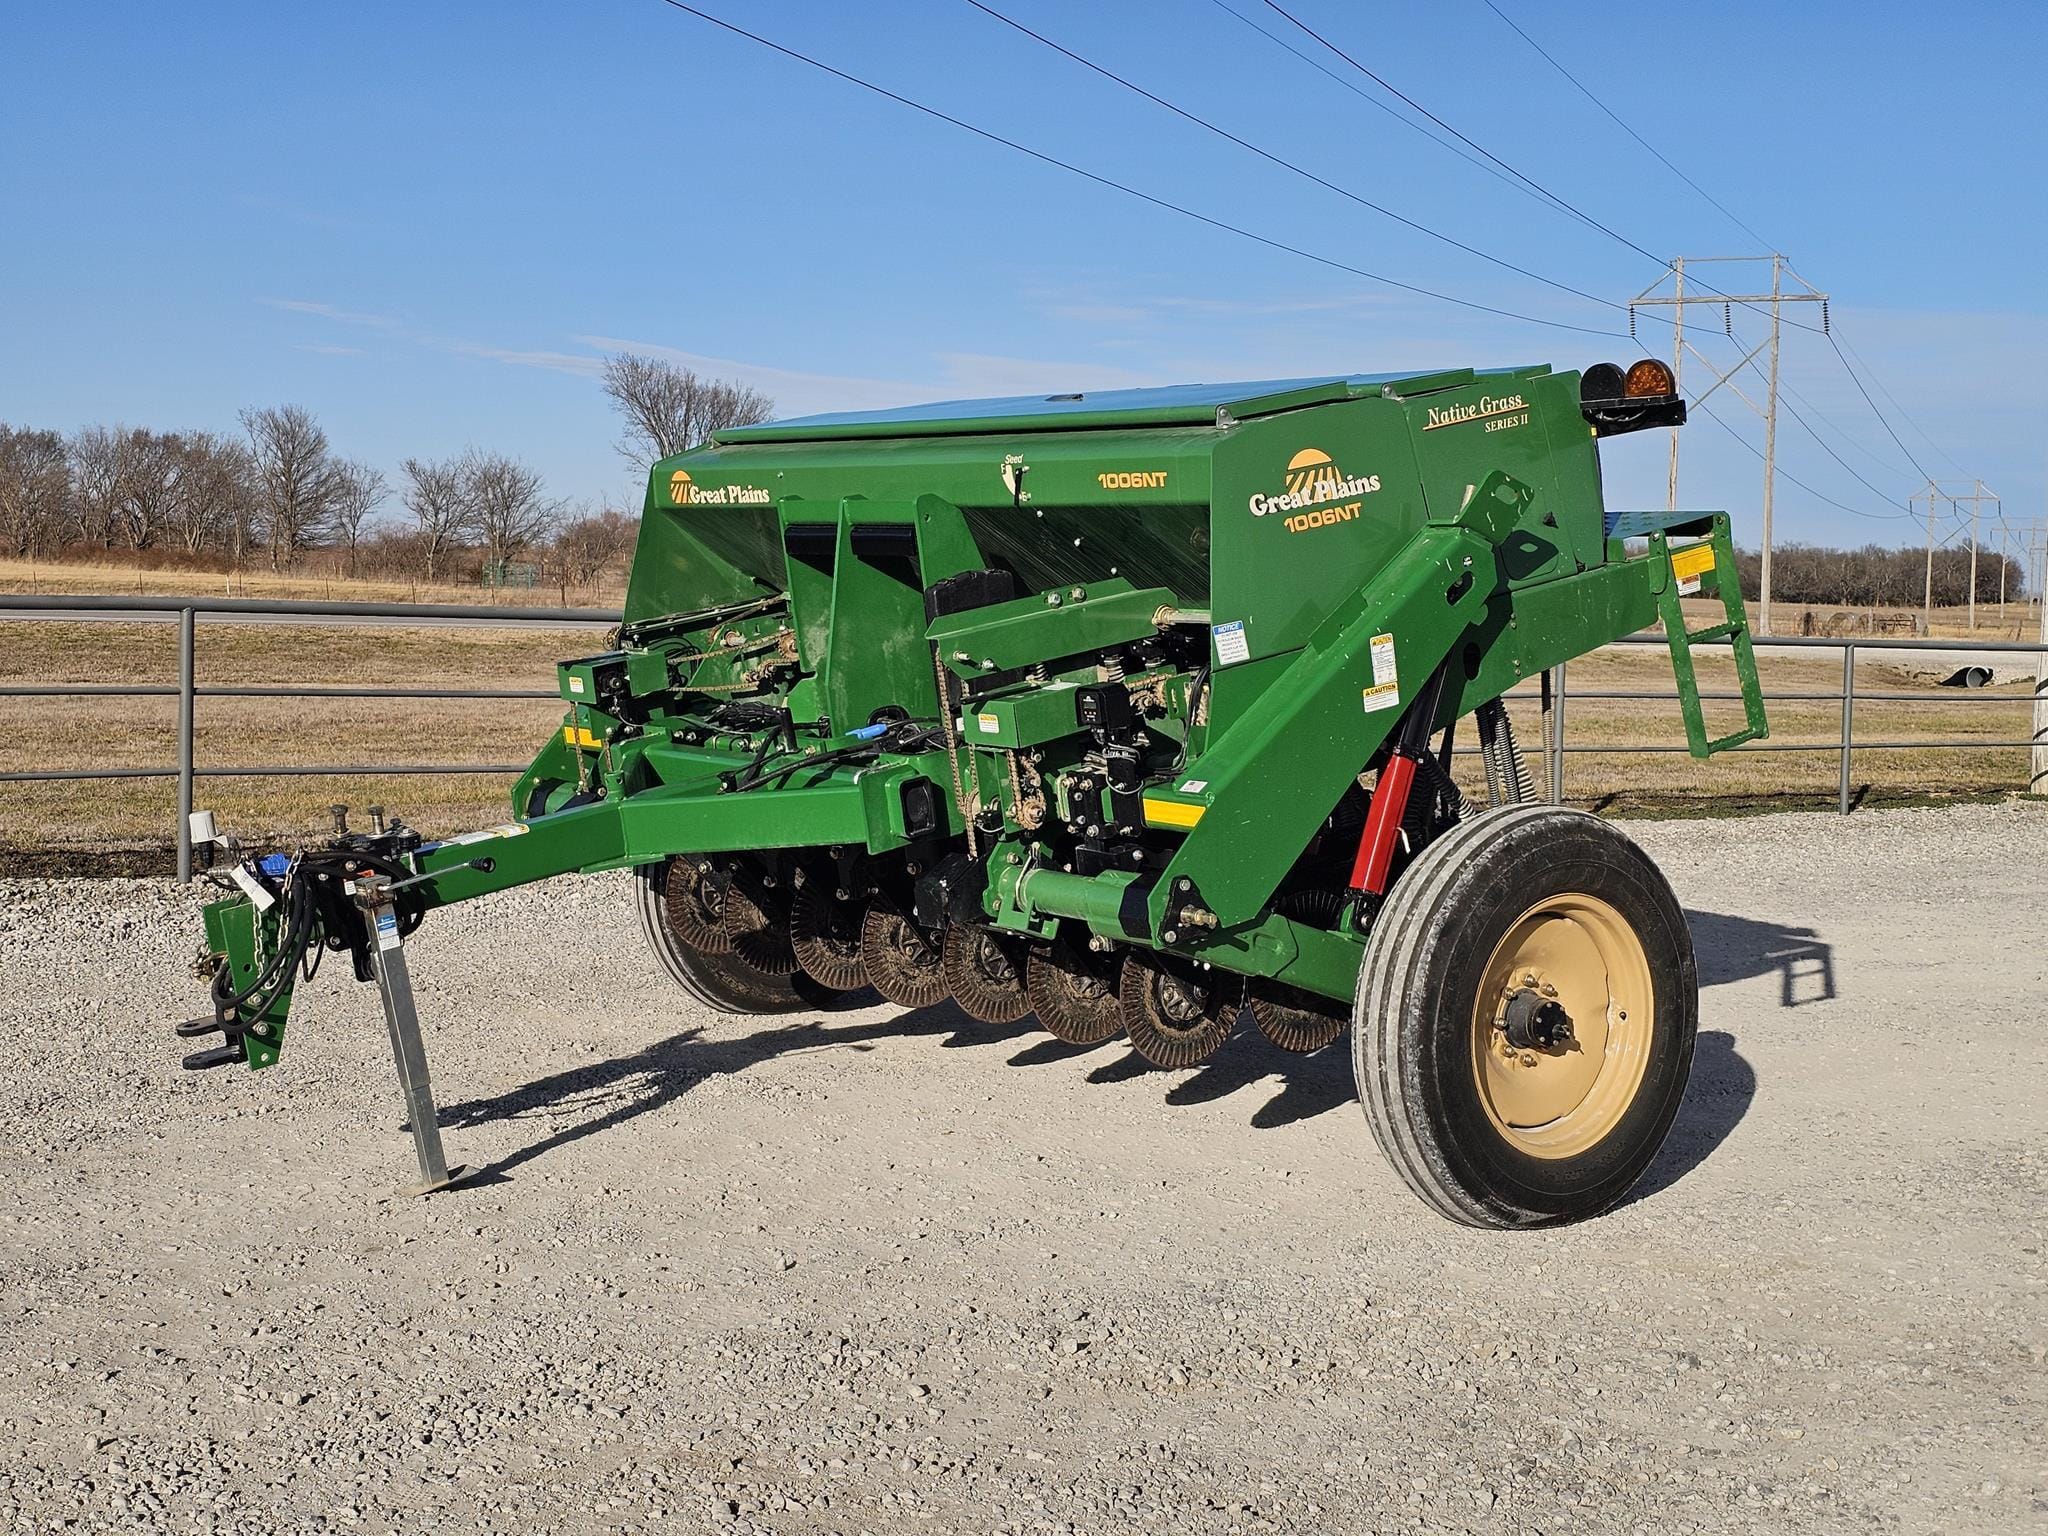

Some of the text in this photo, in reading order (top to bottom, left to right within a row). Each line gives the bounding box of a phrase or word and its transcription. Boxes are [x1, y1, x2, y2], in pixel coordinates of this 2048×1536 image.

[1427, 394, 1522, 426] Native Grass
[1485, 414, 1528, 433] SERIES II
[1004, 453, 1024, 464] Seed
[1097, 472, 1168, 489] 1006NT
[689, 485, 770, 504] Great Plains
[1249, 474, 1381, 517] Great Plains
[1283, 502, 1362, 533] 1006NT
[1217, 622, 1240, 633] NOTICE
[1370, 683, 1396, 695] CAUTION
